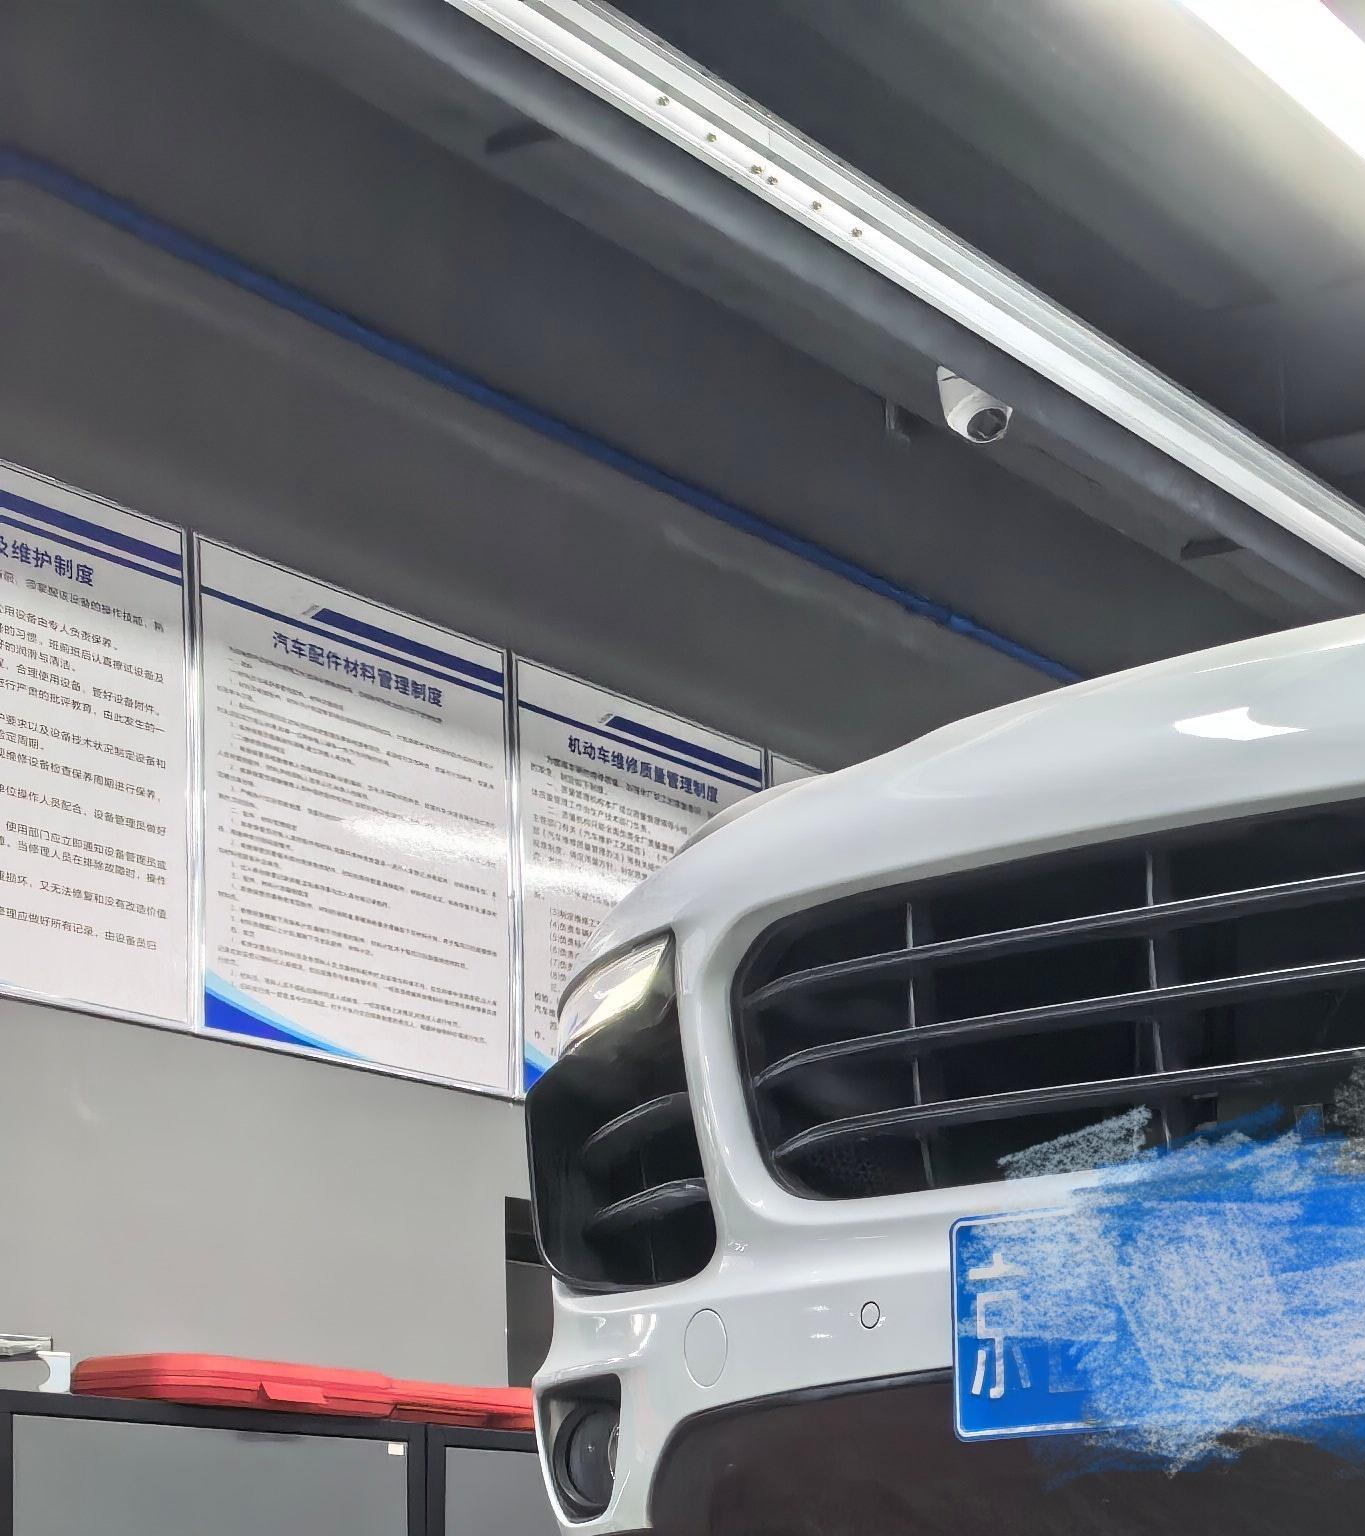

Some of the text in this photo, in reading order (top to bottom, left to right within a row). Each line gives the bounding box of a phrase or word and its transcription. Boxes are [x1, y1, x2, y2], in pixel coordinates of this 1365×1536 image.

[272, 630, 443, 707] 汽车配件材料管理制度
[567, 734, 718, 803] 机动车维修质量管理制度
